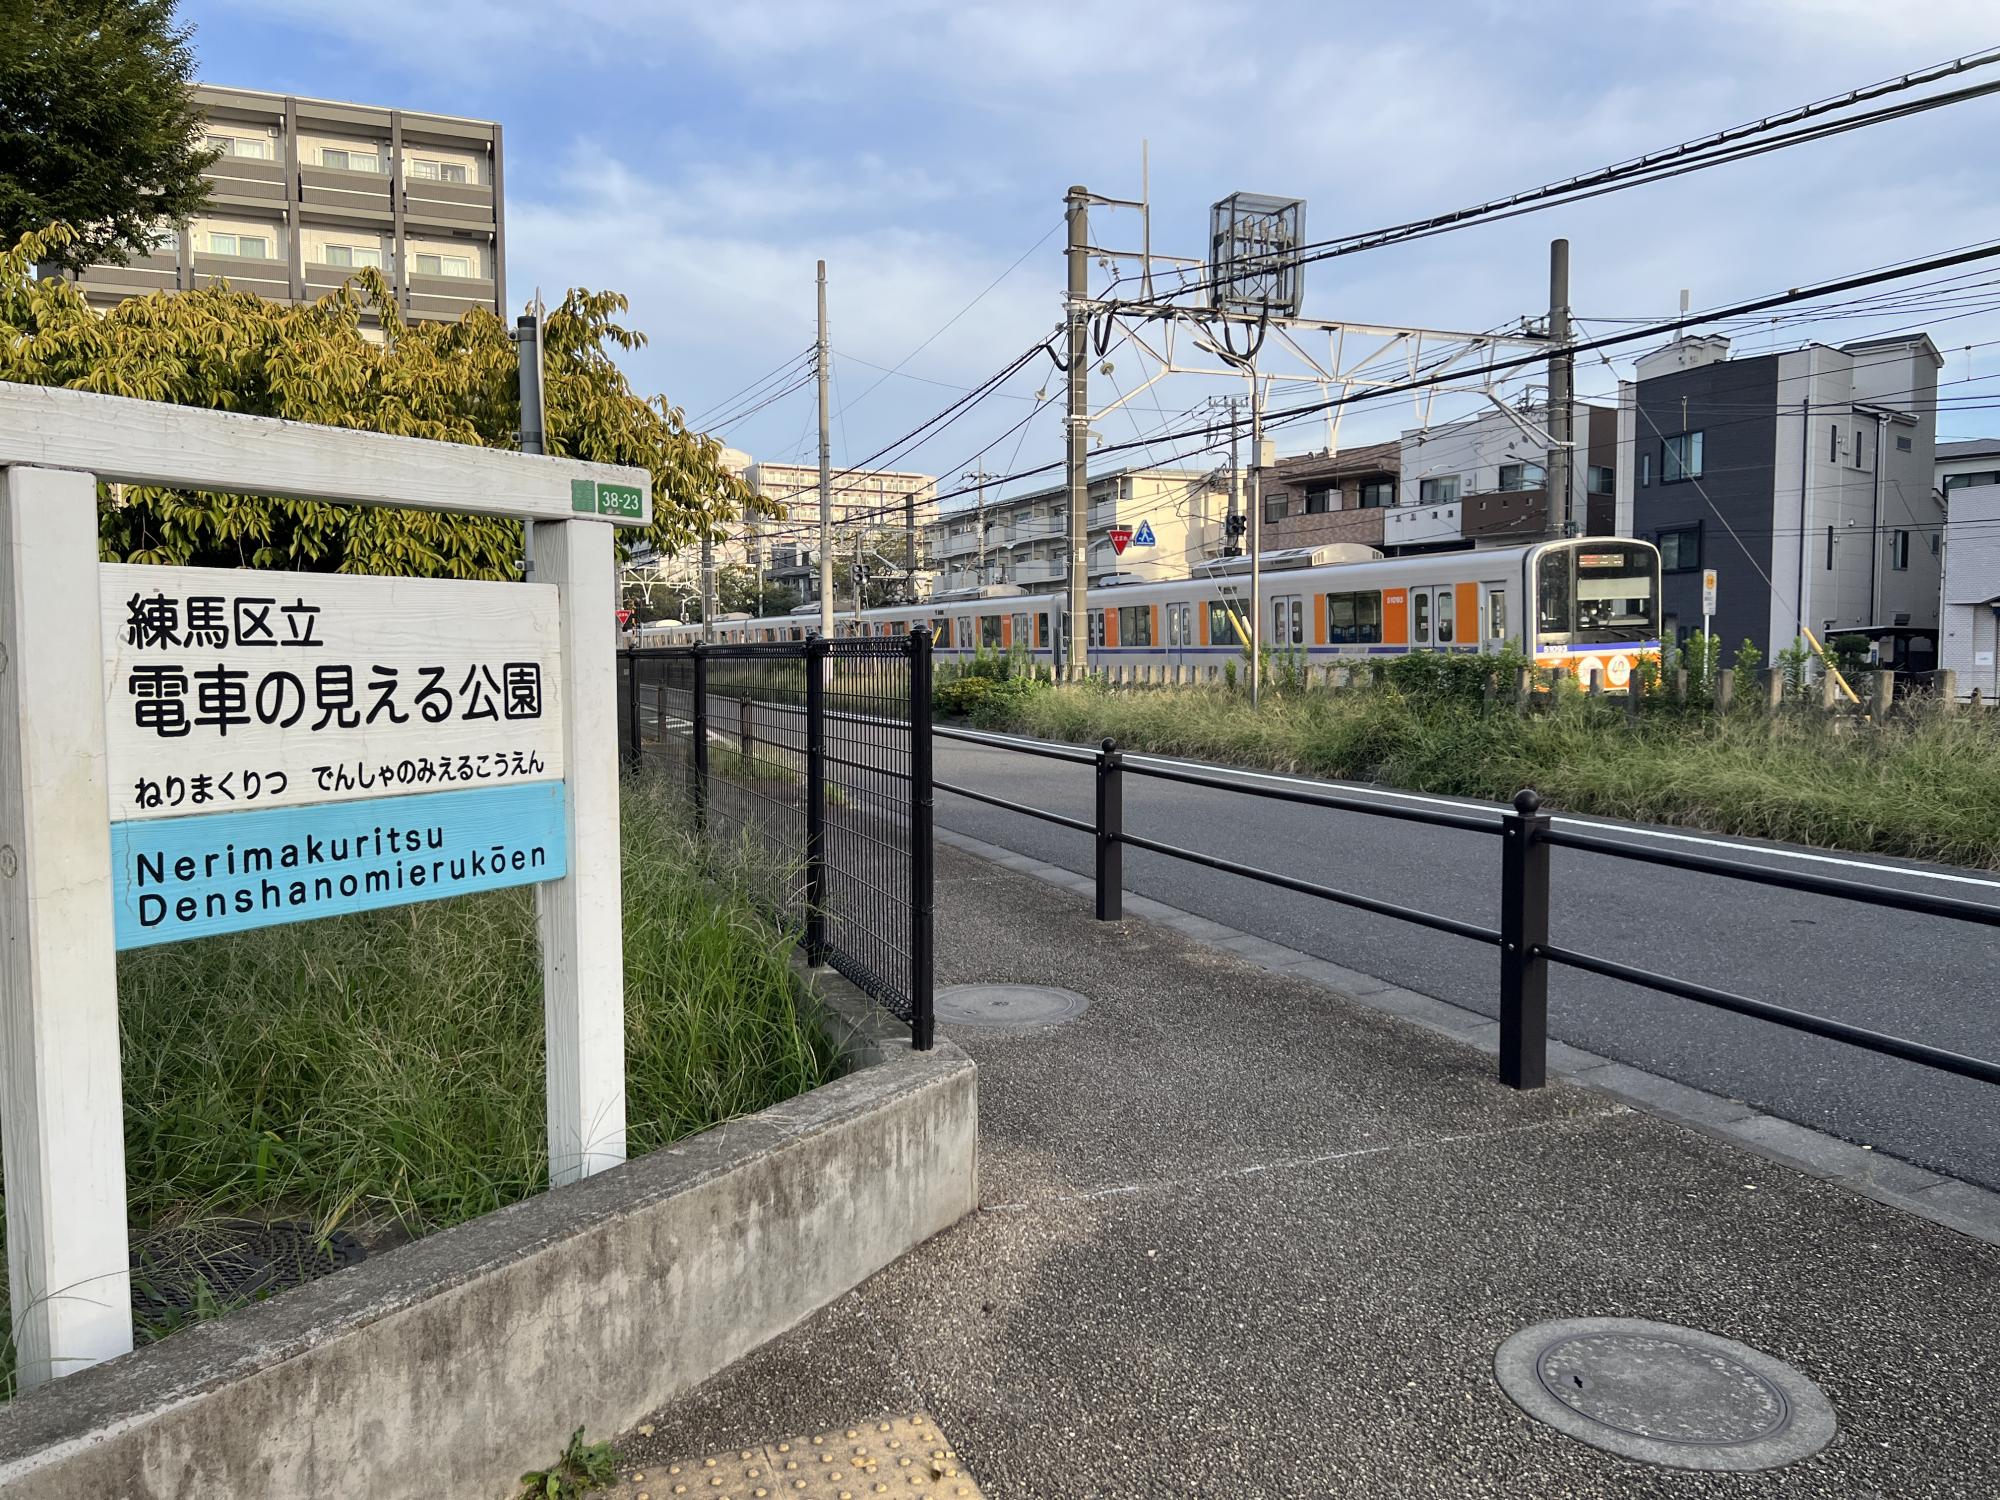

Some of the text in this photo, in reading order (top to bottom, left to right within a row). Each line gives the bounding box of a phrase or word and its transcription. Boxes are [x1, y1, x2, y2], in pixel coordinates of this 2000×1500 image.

[602, 491, 639, 510] 38-23
[127, 593, 323, 650] 練馬区立
[129, 663, 541, 737] 電車の見える公園
[134, 750, 543, 809] ねりまくりつ でんしゃのみえるこうえん
[137, 827, 442, 886] Nerimakuritsu
[140, 846, 544, 927] Denshanomierukōen
